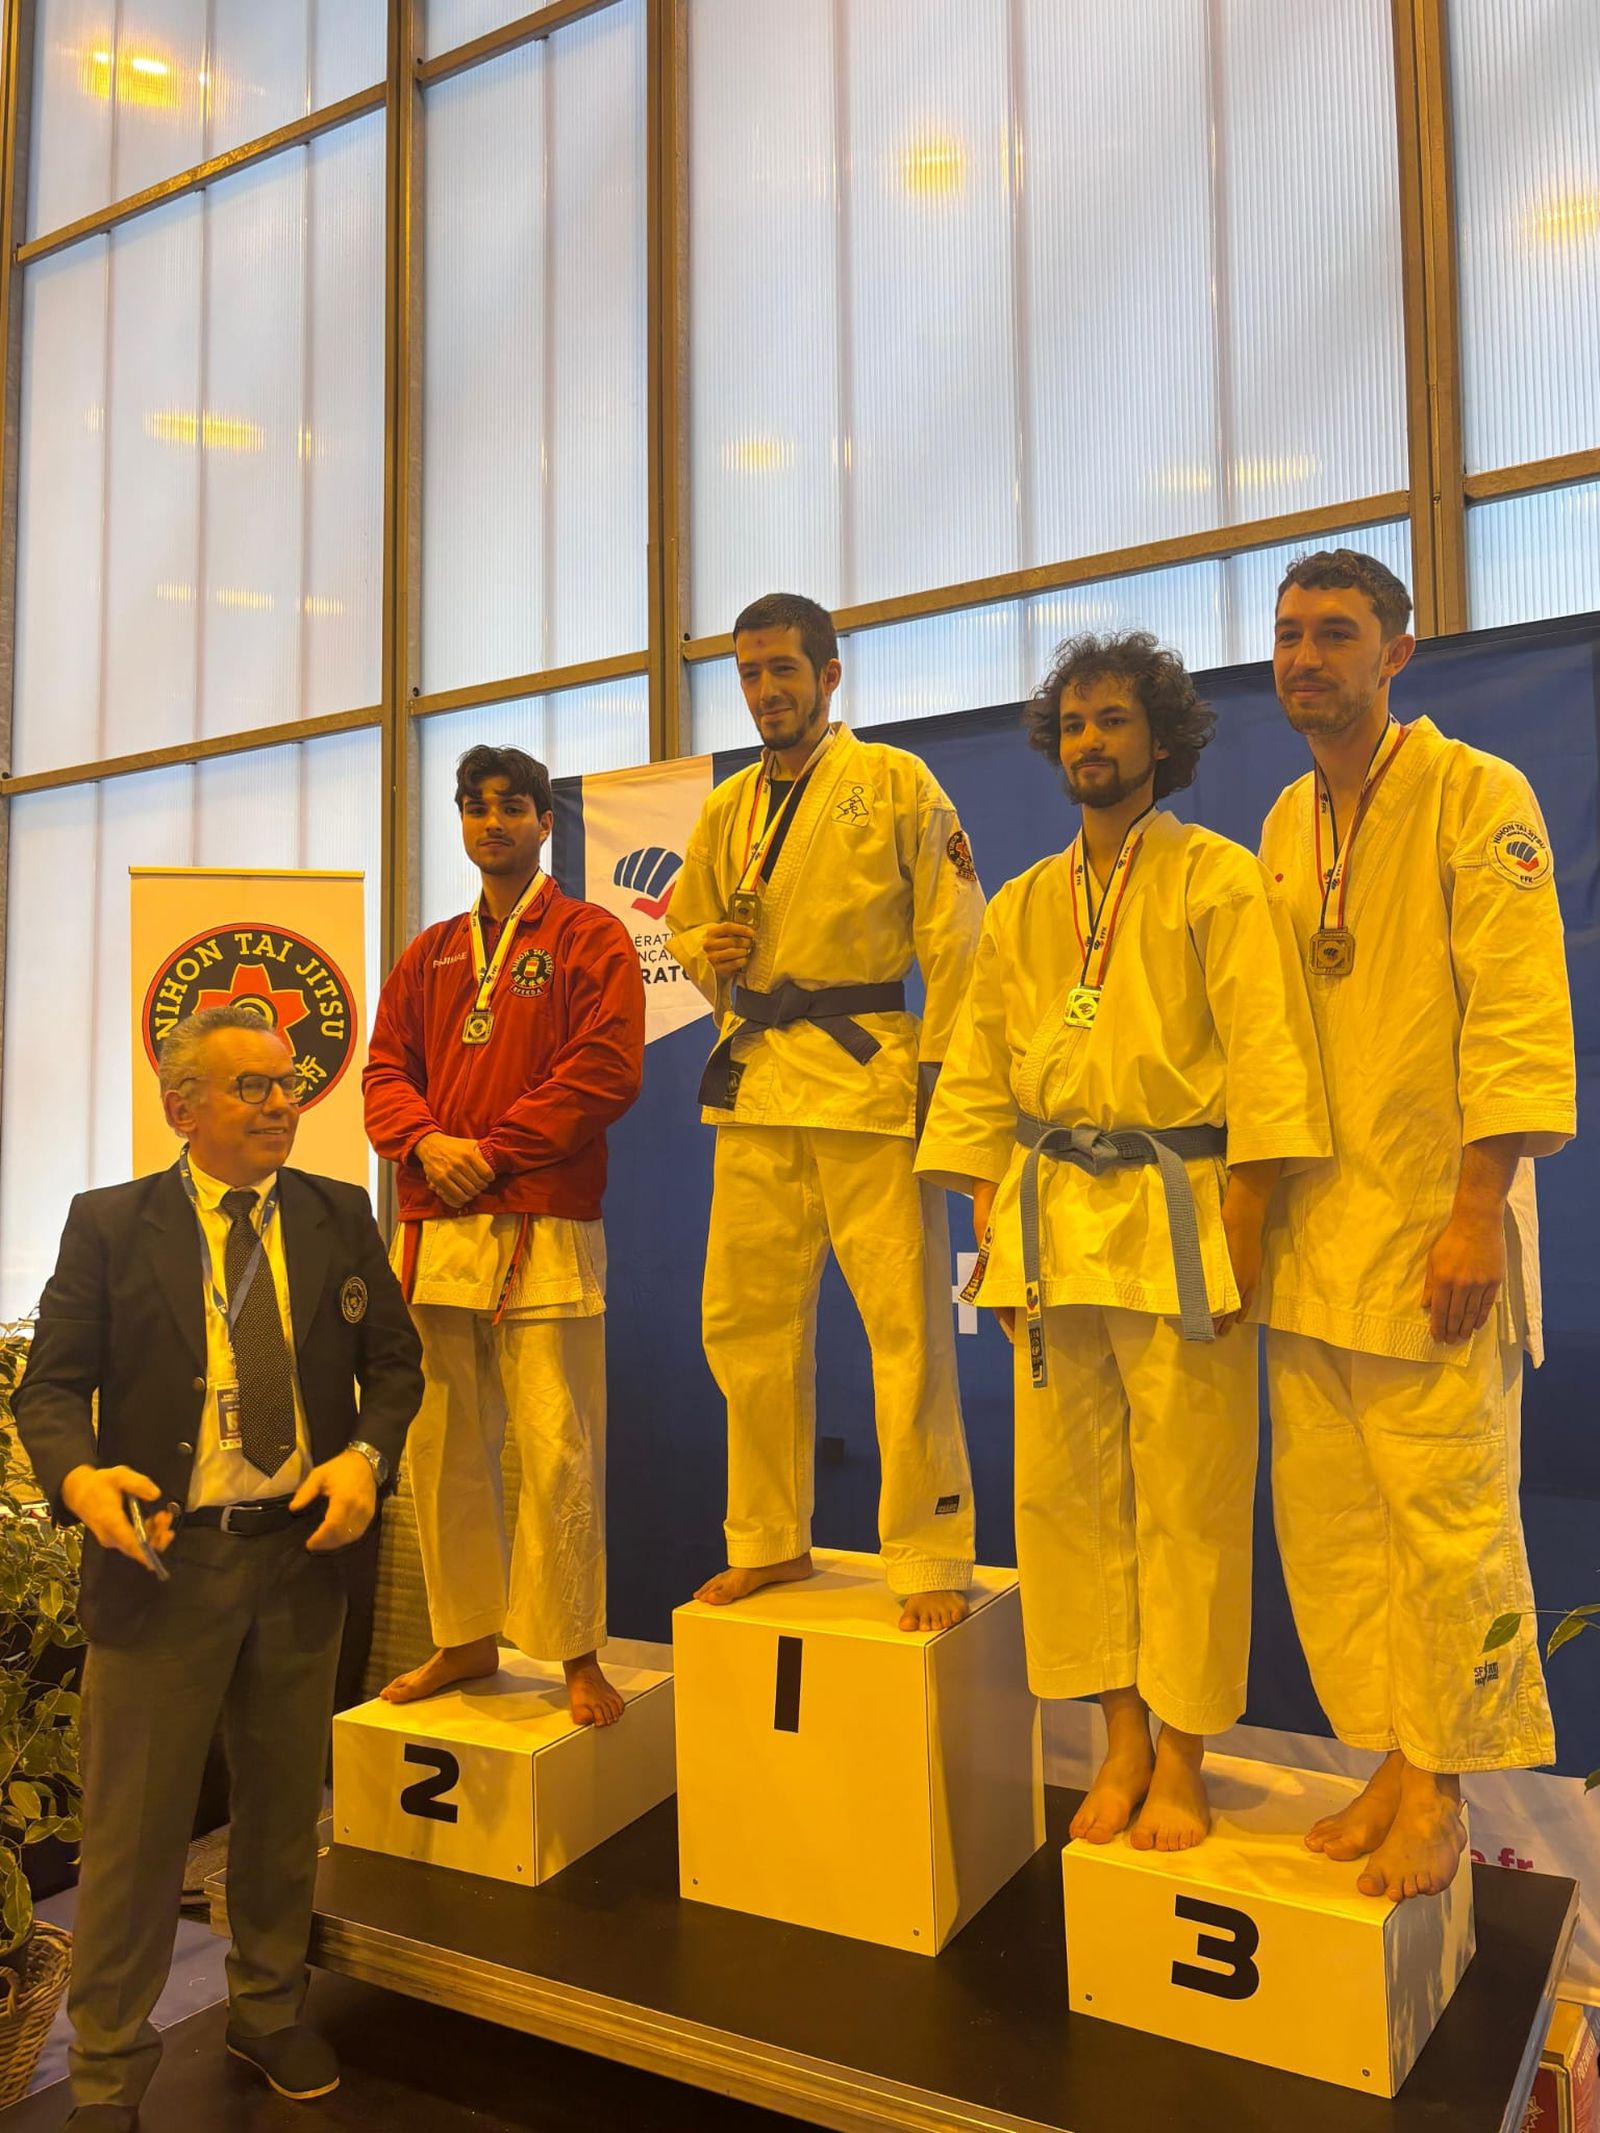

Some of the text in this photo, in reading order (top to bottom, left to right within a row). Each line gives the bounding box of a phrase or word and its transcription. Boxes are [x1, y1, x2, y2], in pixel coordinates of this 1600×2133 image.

[1493, 824, 1515, 844] NIHON
[1520, 875, 1533, 883] FFK
[634, 932, 674, 947] ÉRAT
[154, 933, 344, 1041] NIHON TAI JITSU
[400, 1743, 460, 1824] 2
[1171, 1894, 1260, 2001] 3
